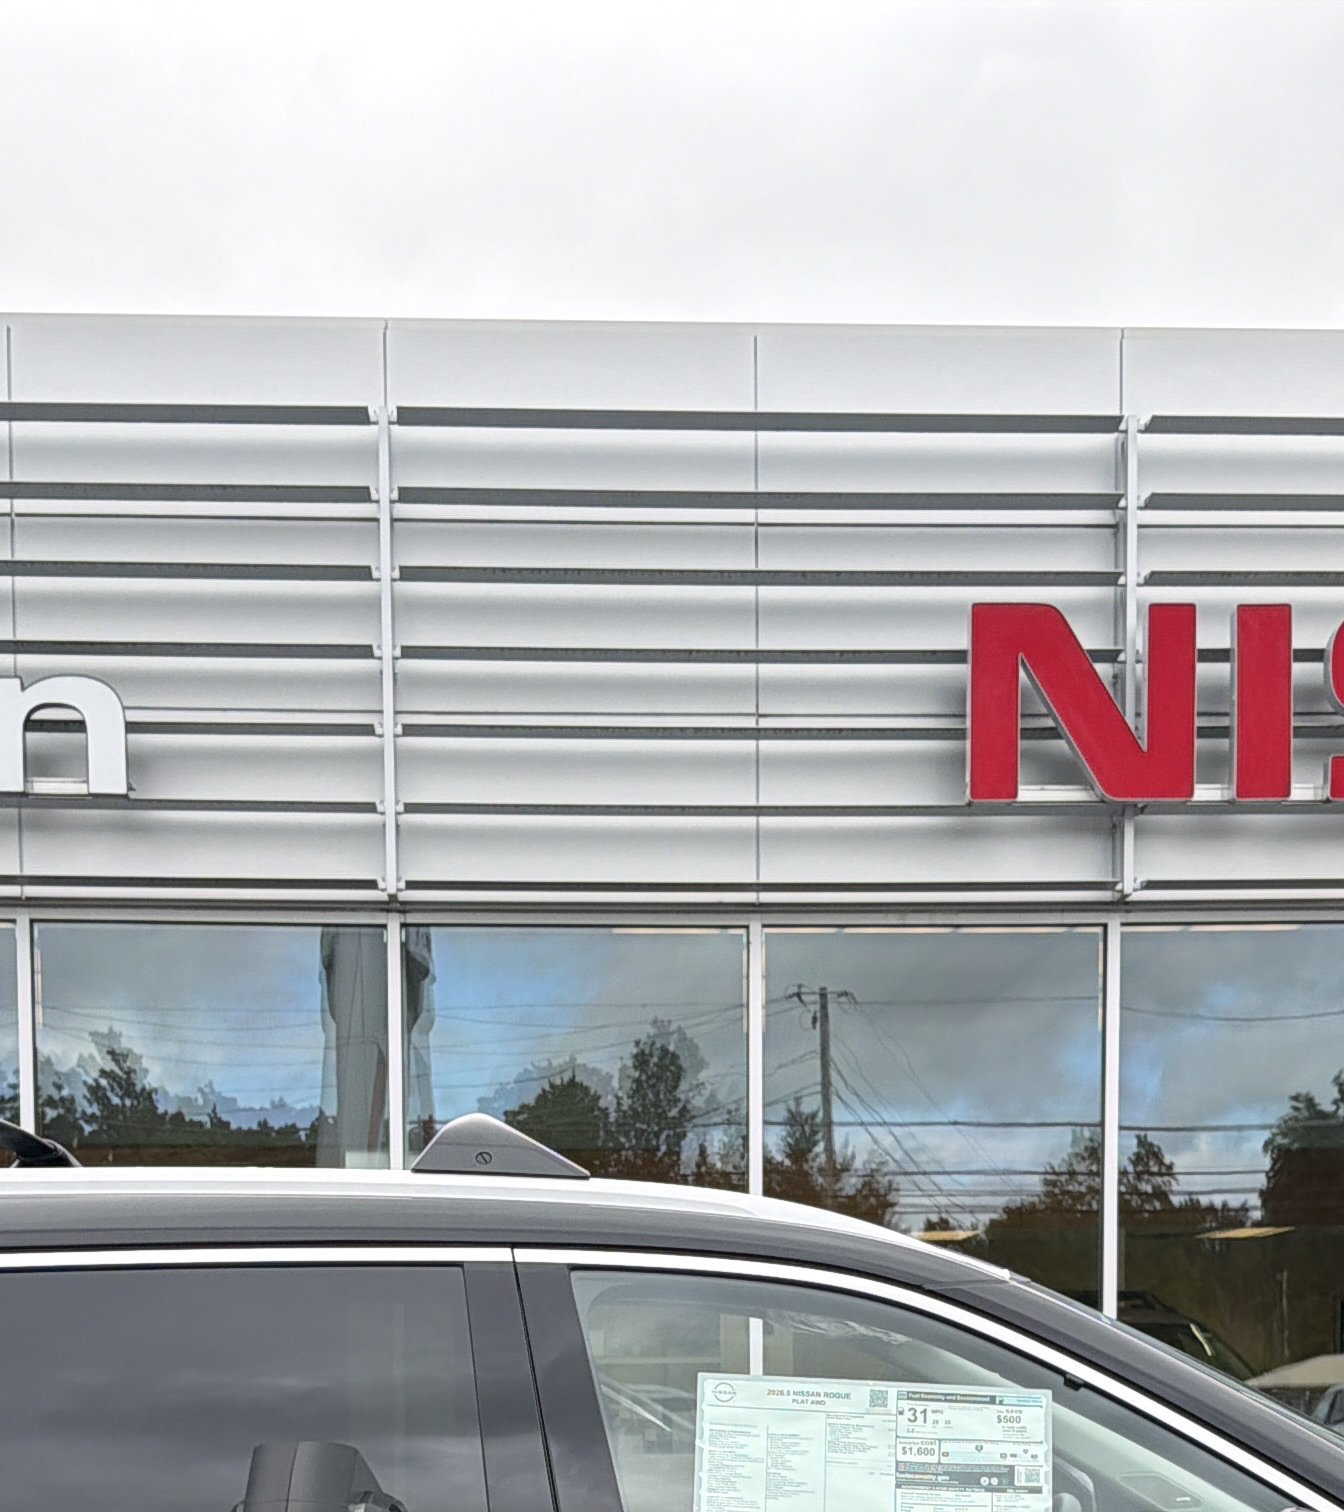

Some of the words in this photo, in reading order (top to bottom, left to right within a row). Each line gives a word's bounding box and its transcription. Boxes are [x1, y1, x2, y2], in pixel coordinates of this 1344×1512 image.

[767, 1388, 791, 1397] 2026.5
[792, 1390, 822, 1399] NISSAN
[823, 1391, 852, 1400] ROGUE
[907, 1407, 928, 1424] 31
[996, 1414, 1022, 1424] $500
[901, 1446, 936, 1457] $1,600
